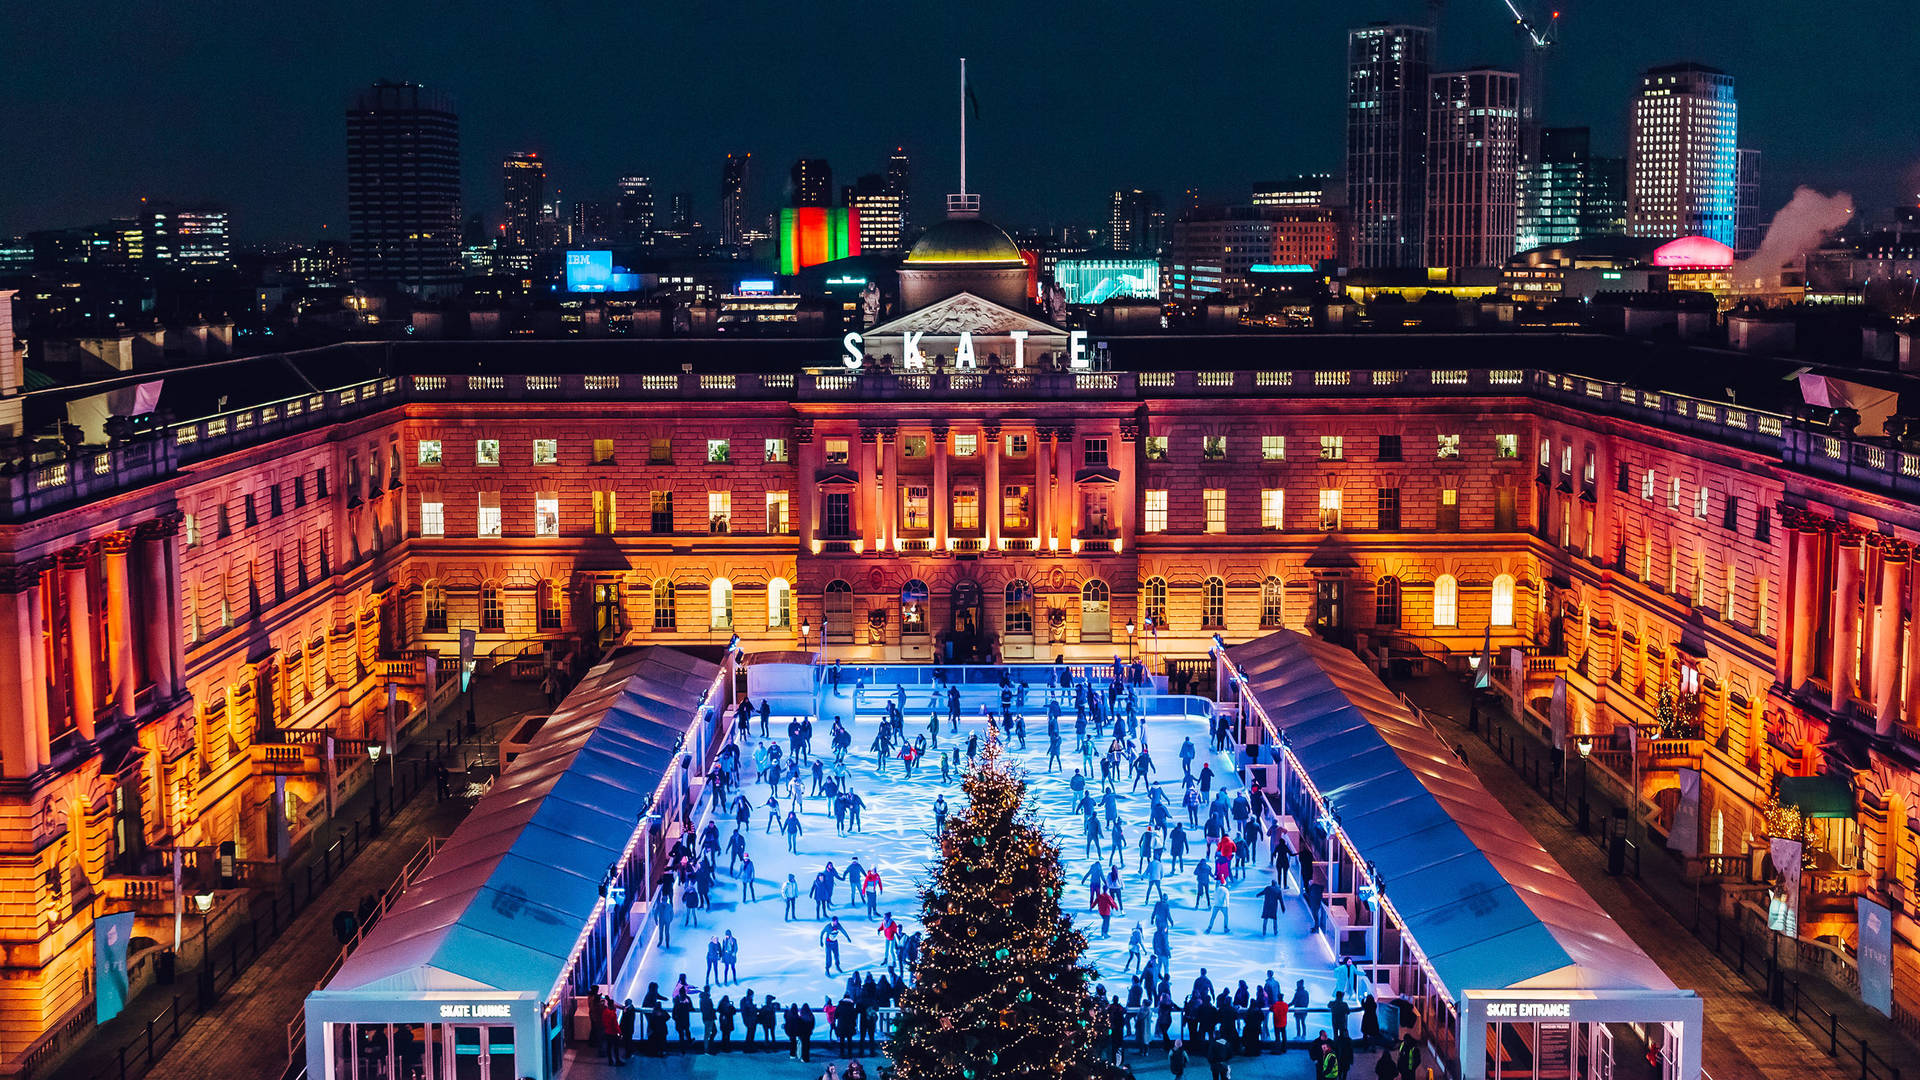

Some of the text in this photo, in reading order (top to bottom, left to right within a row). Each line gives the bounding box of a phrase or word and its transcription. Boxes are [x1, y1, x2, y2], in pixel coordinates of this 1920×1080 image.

[568, 254, 591, 265] IBM
[843, 330, 1090, 369] SKATE
[440, 1004, 512, 1017] SKATE LOUNGE
[1486, 1003, 1571, 1017] SKATE ENTRANCE
